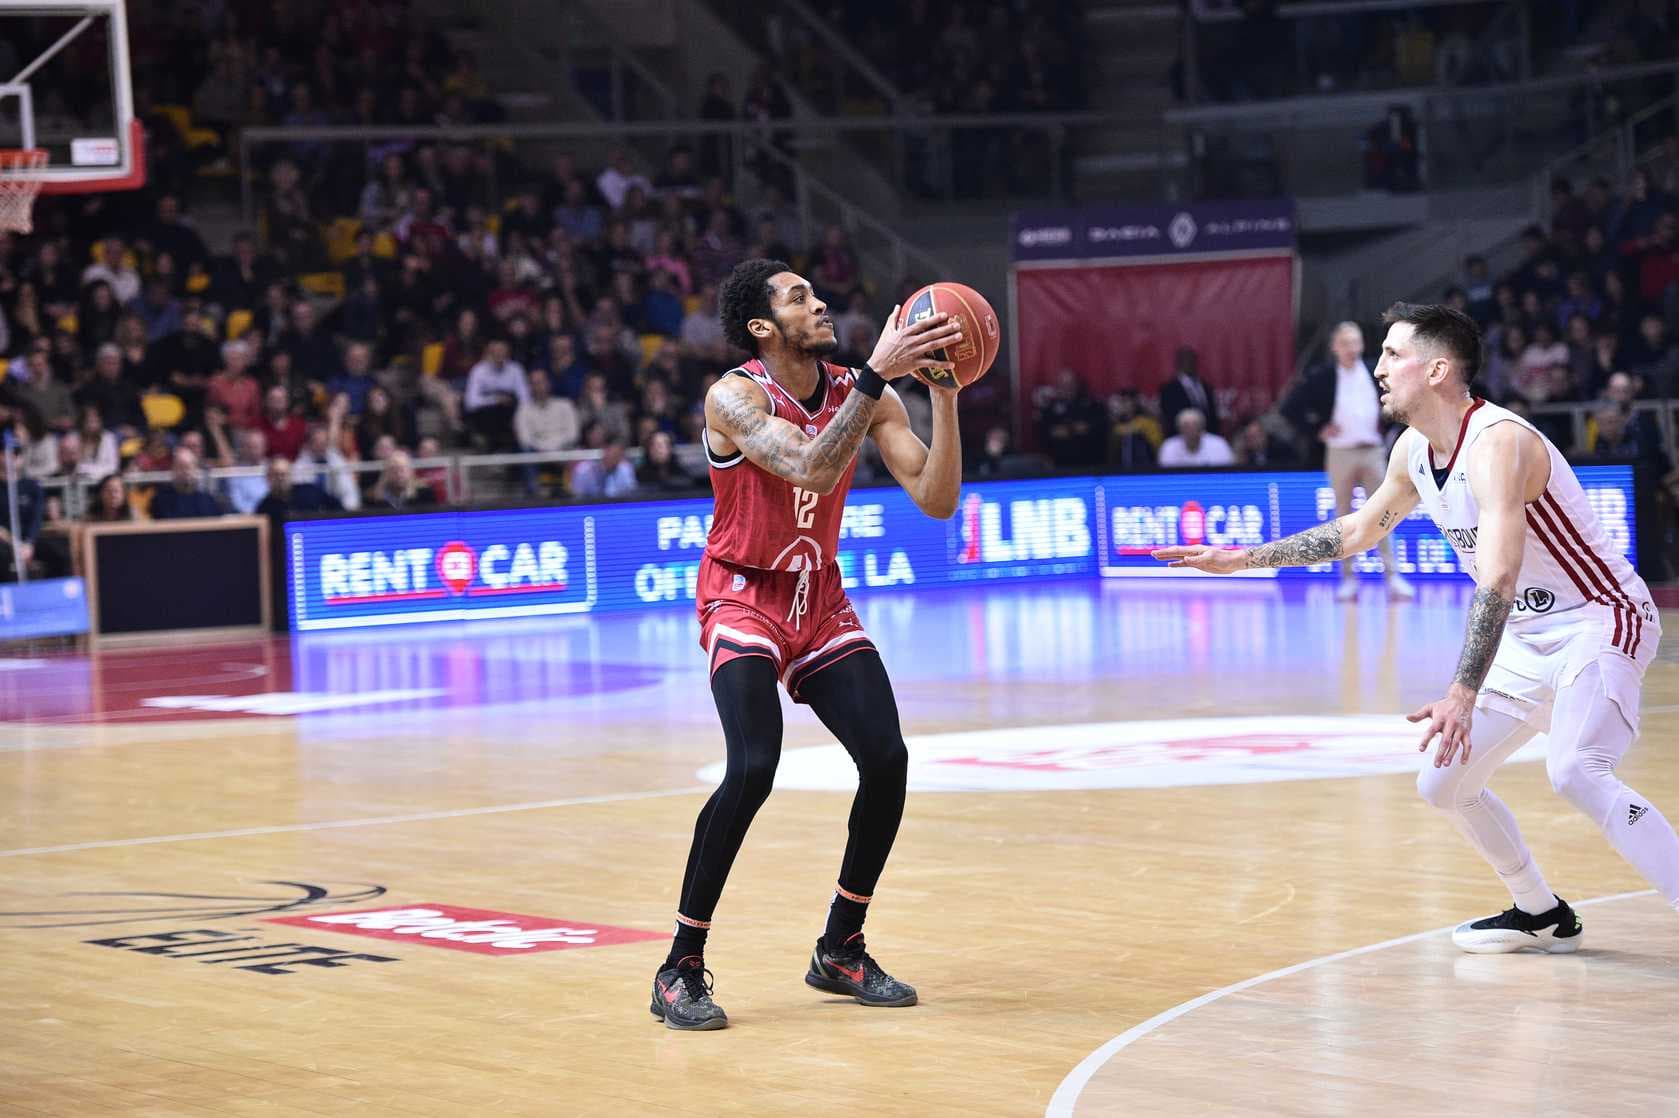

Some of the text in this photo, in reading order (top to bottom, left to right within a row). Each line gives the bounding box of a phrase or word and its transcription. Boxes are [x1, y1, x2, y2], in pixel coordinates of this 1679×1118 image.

[792, 486, 820, 529] 12
[1112, 505, 1180, 546] RENT
[1205, 504, 1264, 545] CAR
[981, 497, 1091, 563] LNB
[320, 540, 569, 600] RENT CAR
[864, 548, 916, 587] LA
[1628, 806, 1648, 826] adidas
